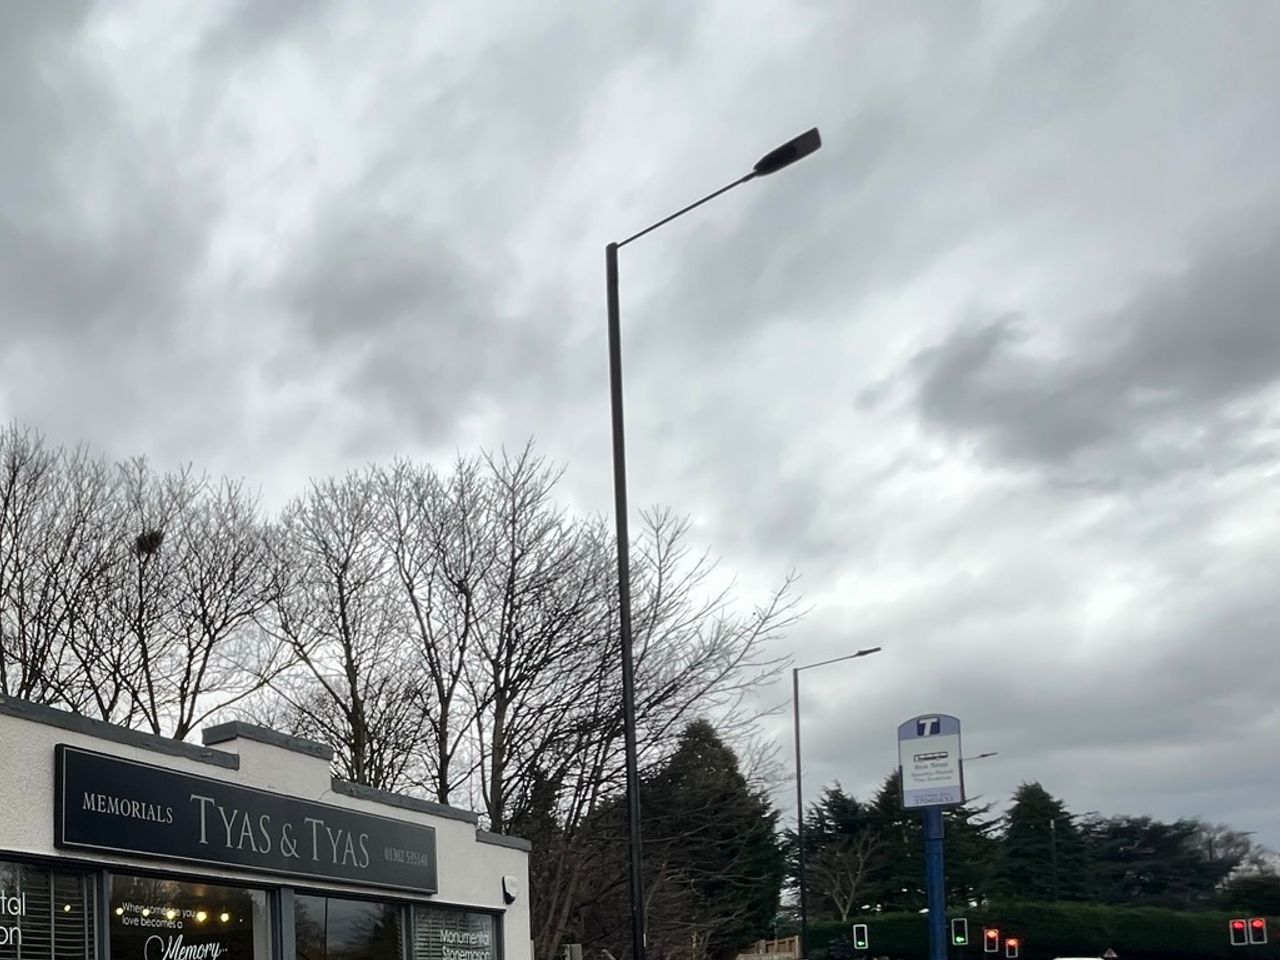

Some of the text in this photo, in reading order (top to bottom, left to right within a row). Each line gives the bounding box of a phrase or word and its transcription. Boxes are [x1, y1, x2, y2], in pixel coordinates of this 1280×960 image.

[82, 791, 173, 824] MEMORIALS
[190, 793, 271, 854] TYAS
[280, 823, 301, 858] &
[304, 817, 369, 868] TYAS
[122, 915, 139, 926] love
[141, 917, 176, 929] becomes
